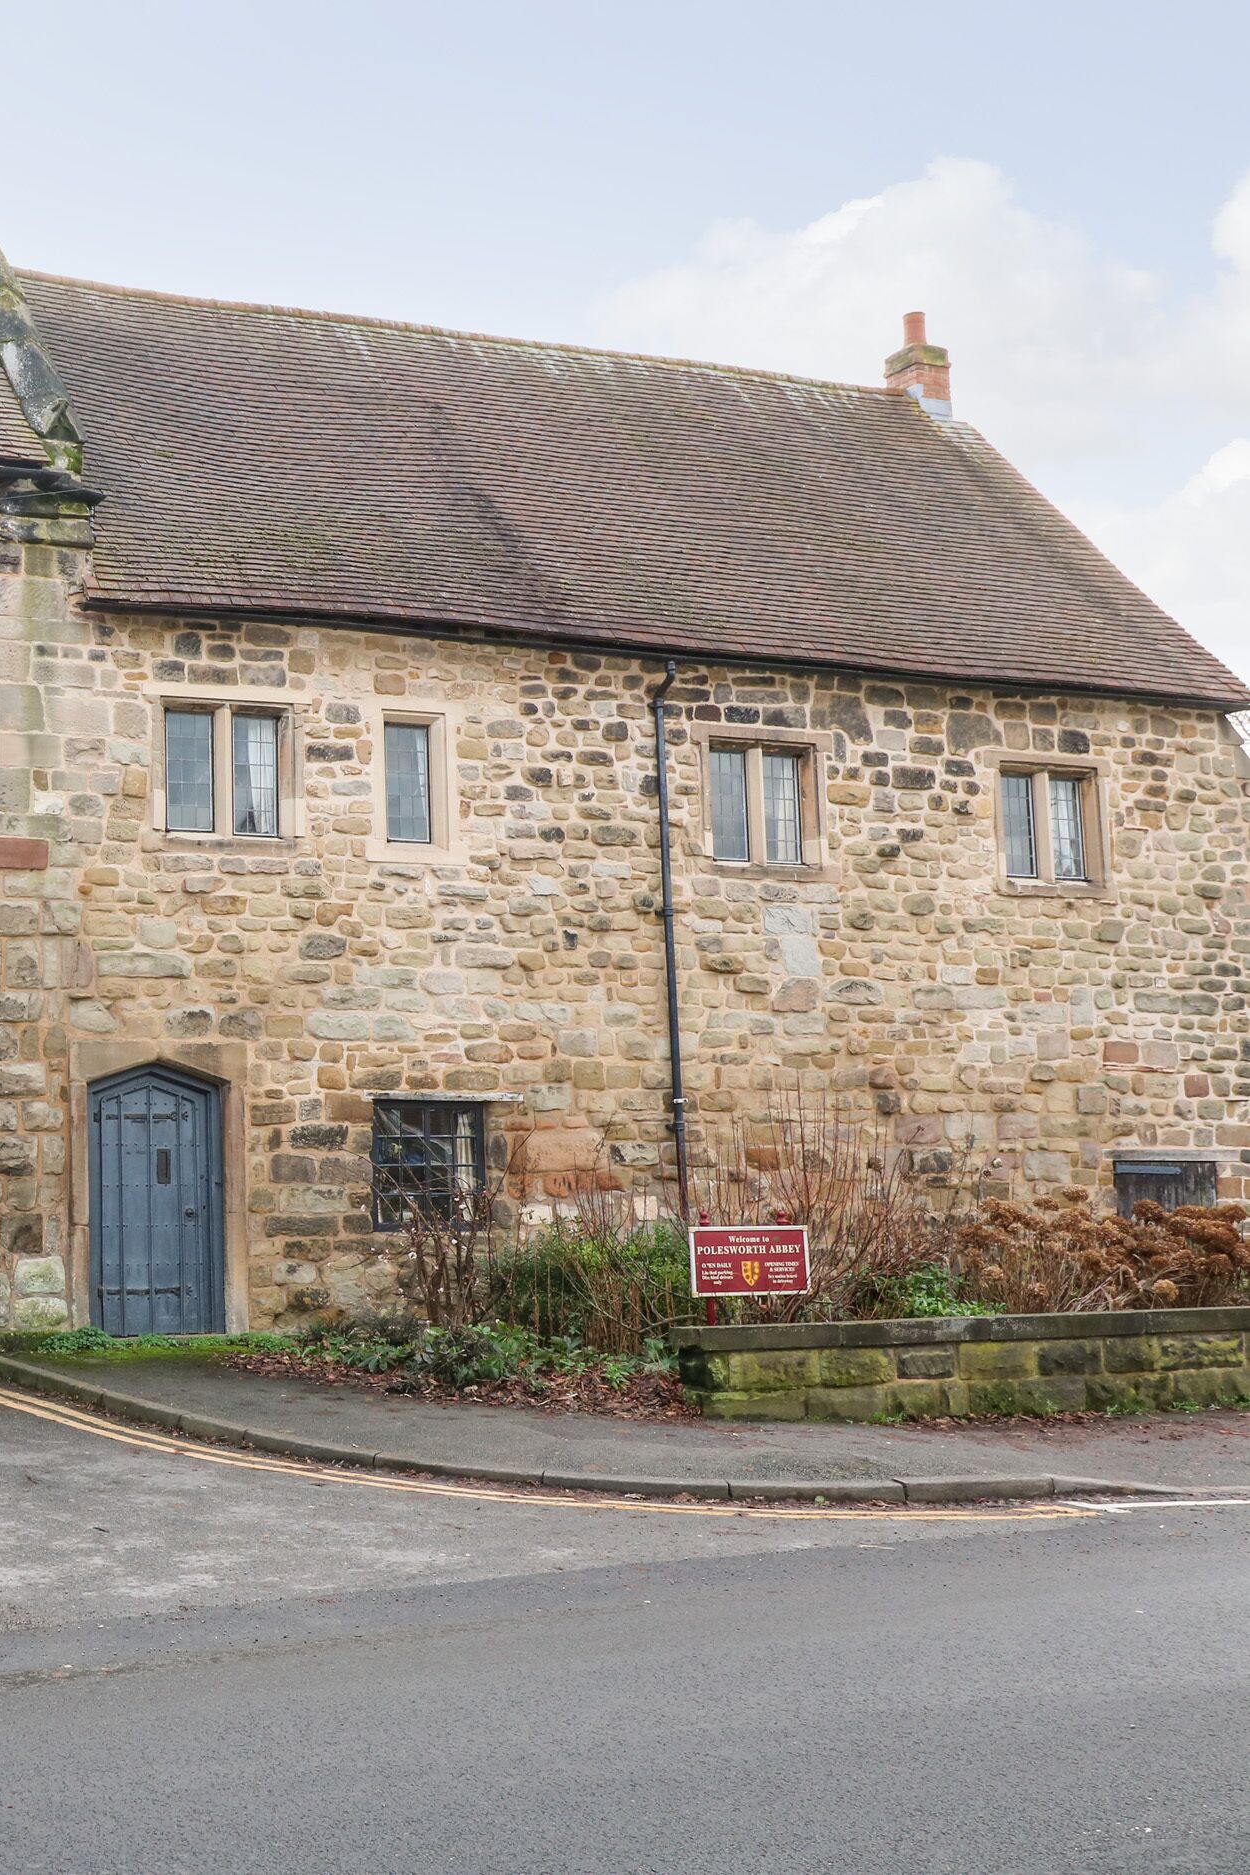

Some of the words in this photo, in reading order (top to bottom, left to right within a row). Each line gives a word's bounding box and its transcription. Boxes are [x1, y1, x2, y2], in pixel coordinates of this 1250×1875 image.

[728, 1235, 760, 1243] Welcome
[697, 1245, 766, 1255] POLESWORTH
[769, 1244, 801, 1253] ABBEY
